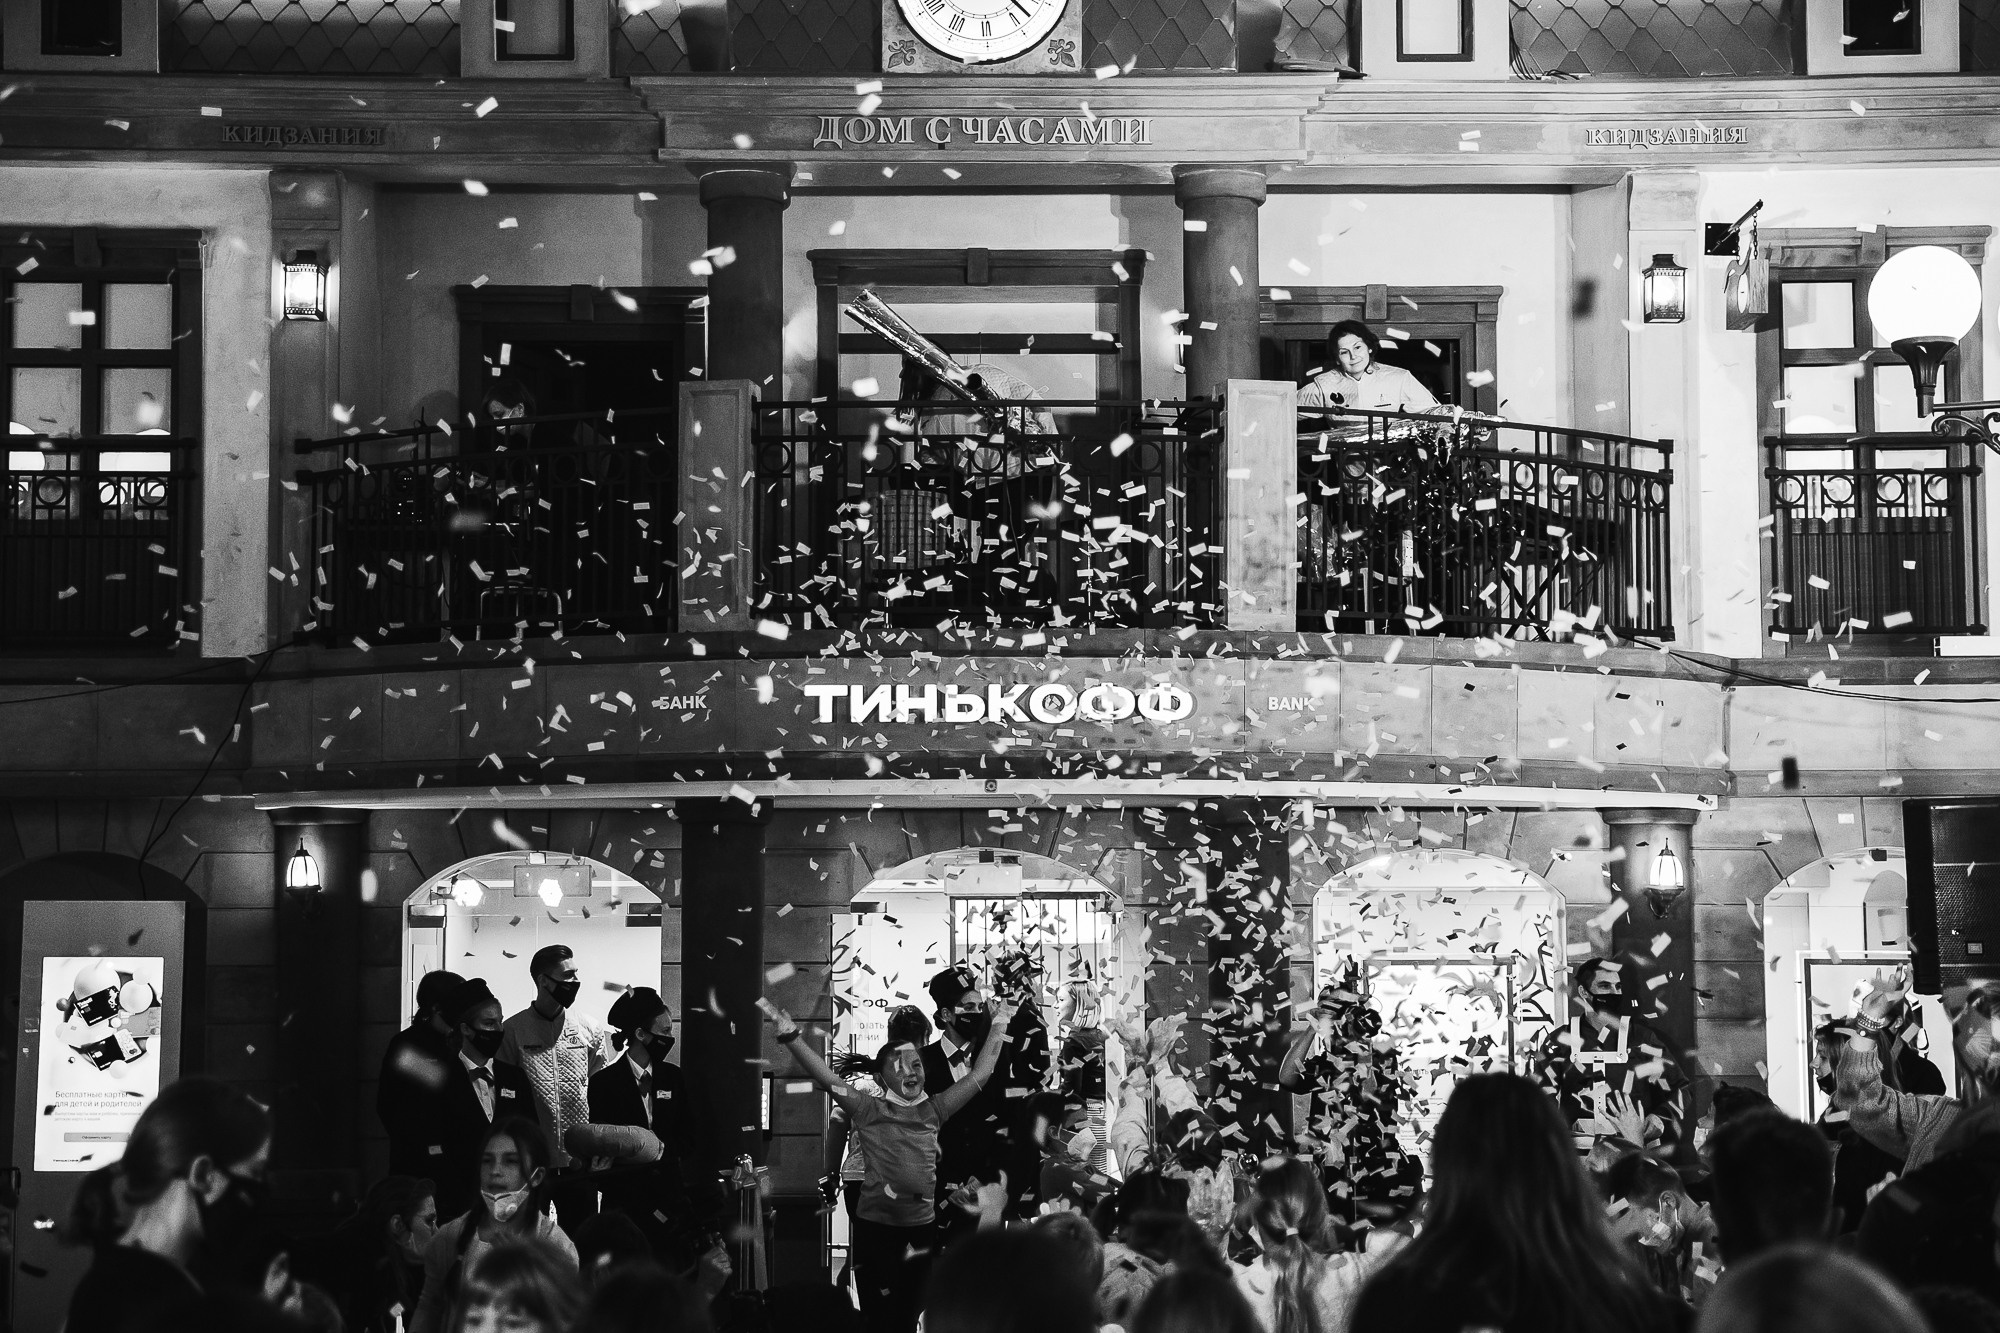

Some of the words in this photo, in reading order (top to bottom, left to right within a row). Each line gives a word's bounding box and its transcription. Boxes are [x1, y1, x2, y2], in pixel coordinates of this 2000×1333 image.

[222, 125, 382, 147] КИДЗАНИЯ
[813, 115, 915, 149] ДОМ
[925, 116, 951, 144] С
[958, 116, 1153, 145] ЧАСАМИ
[1586, 127, 1748, 149] КИДЗАНИЯ
[659, 695, 707, 710] БАНК
[804, 682, 1194, 724] ТИНЬКОФФ
[1268, 696, 1316, 711] BANK
[55, 1090, 103, 1099] Бесплатные
[104, 1092, 128, 1100] карты
[100, 1101, 142, 1109] родителей
